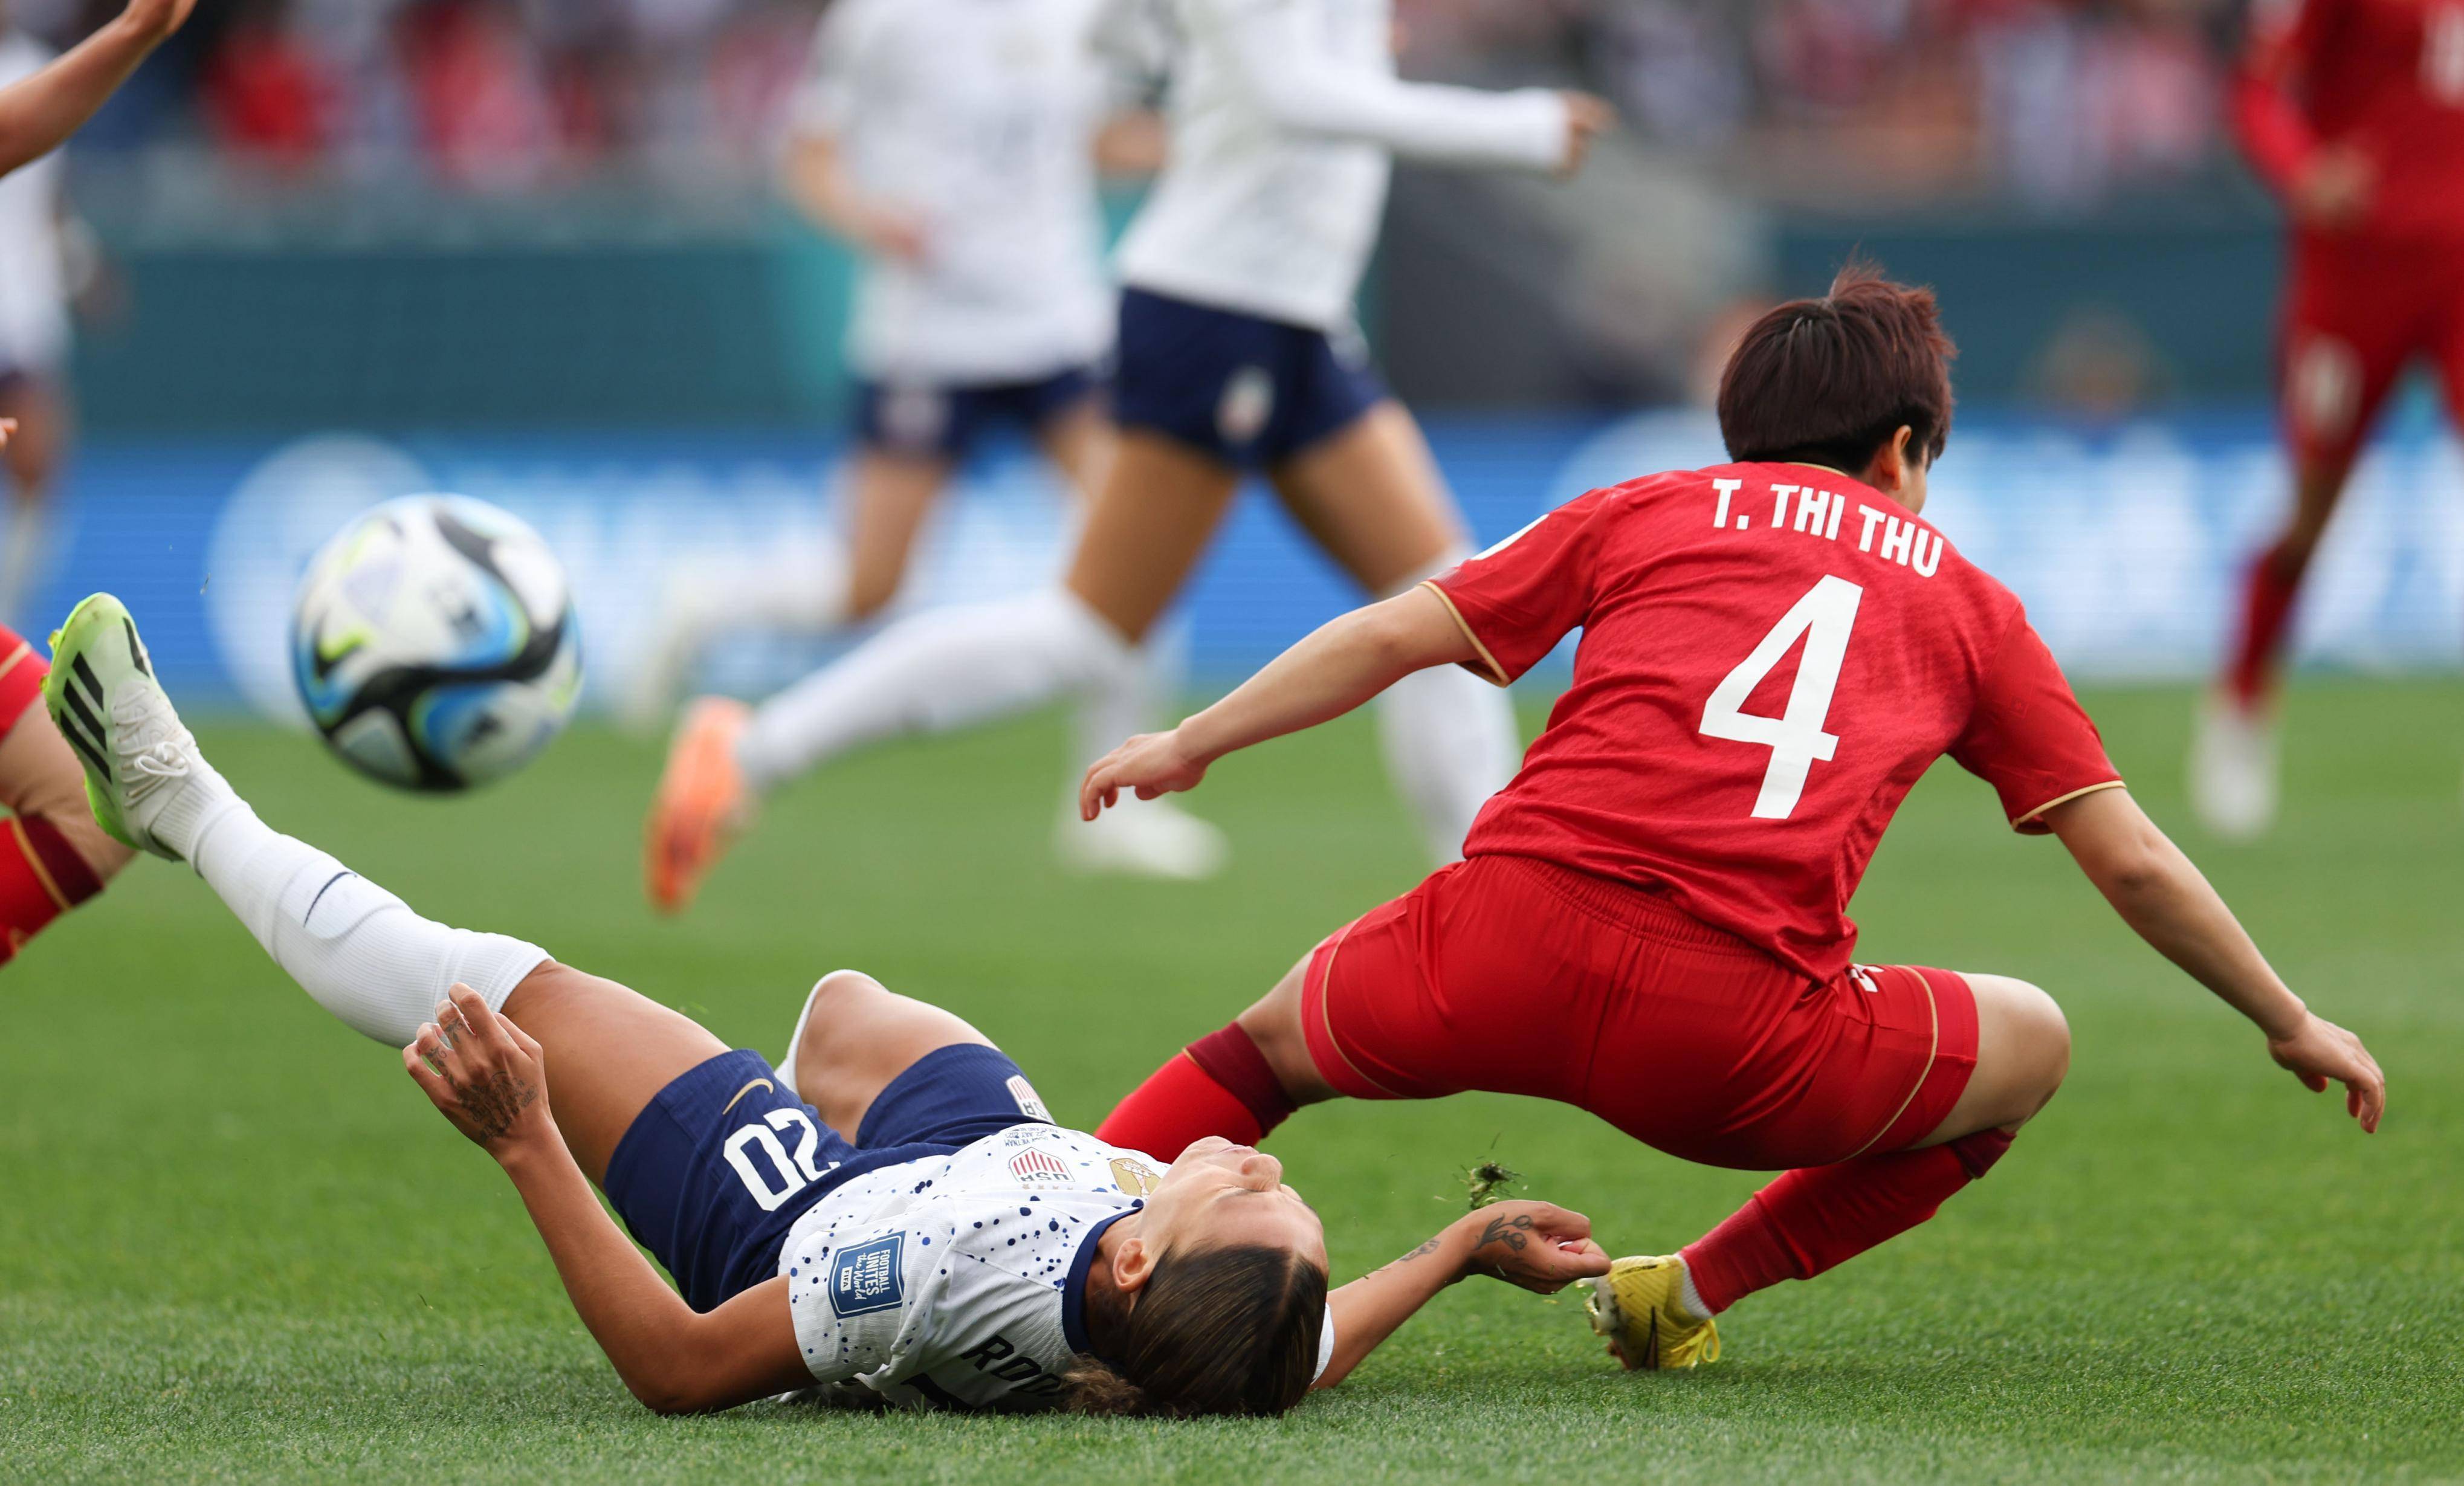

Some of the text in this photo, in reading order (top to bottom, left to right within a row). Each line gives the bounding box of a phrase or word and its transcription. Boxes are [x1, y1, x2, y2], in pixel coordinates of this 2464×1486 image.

[1713, 478, 1944, 577] T. THI THU
[1698, 573, 1864, 819] 4
[723, 1108, 841, 1212] 20
[1020, 1172, 1069, 1181] USA
[853, 1252, 867, 1299] the World
[865, 1251, 881, 1296] UNITES
[879, 1249, 891, 1293] FOOTBALL
[960, 1335, 1062, 1395] ROD
